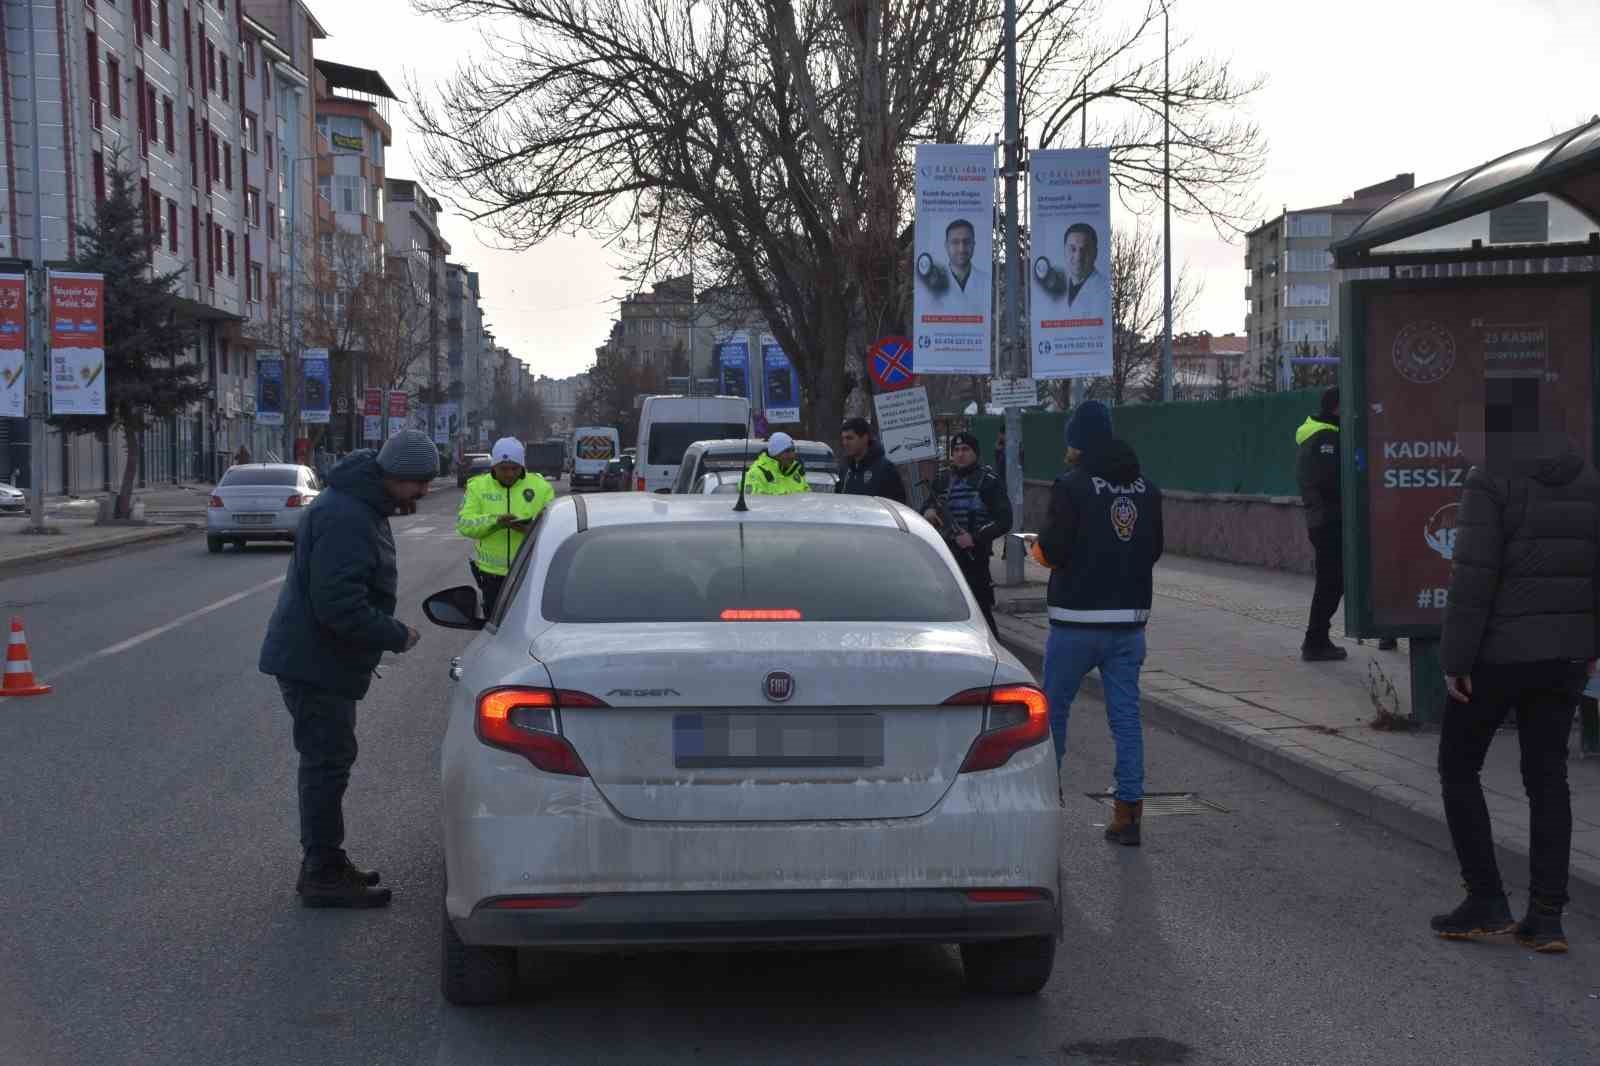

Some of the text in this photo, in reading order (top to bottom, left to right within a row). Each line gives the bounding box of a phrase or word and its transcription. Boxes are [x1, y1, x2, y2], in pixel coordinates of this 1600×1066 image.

[1383, 441, 1464, 459] KADINA
[1383, 465, 1463, 488] SESSİZ
[1416, 588, 1448, 608] #B
[770, 678, 788, 693] FIAT
